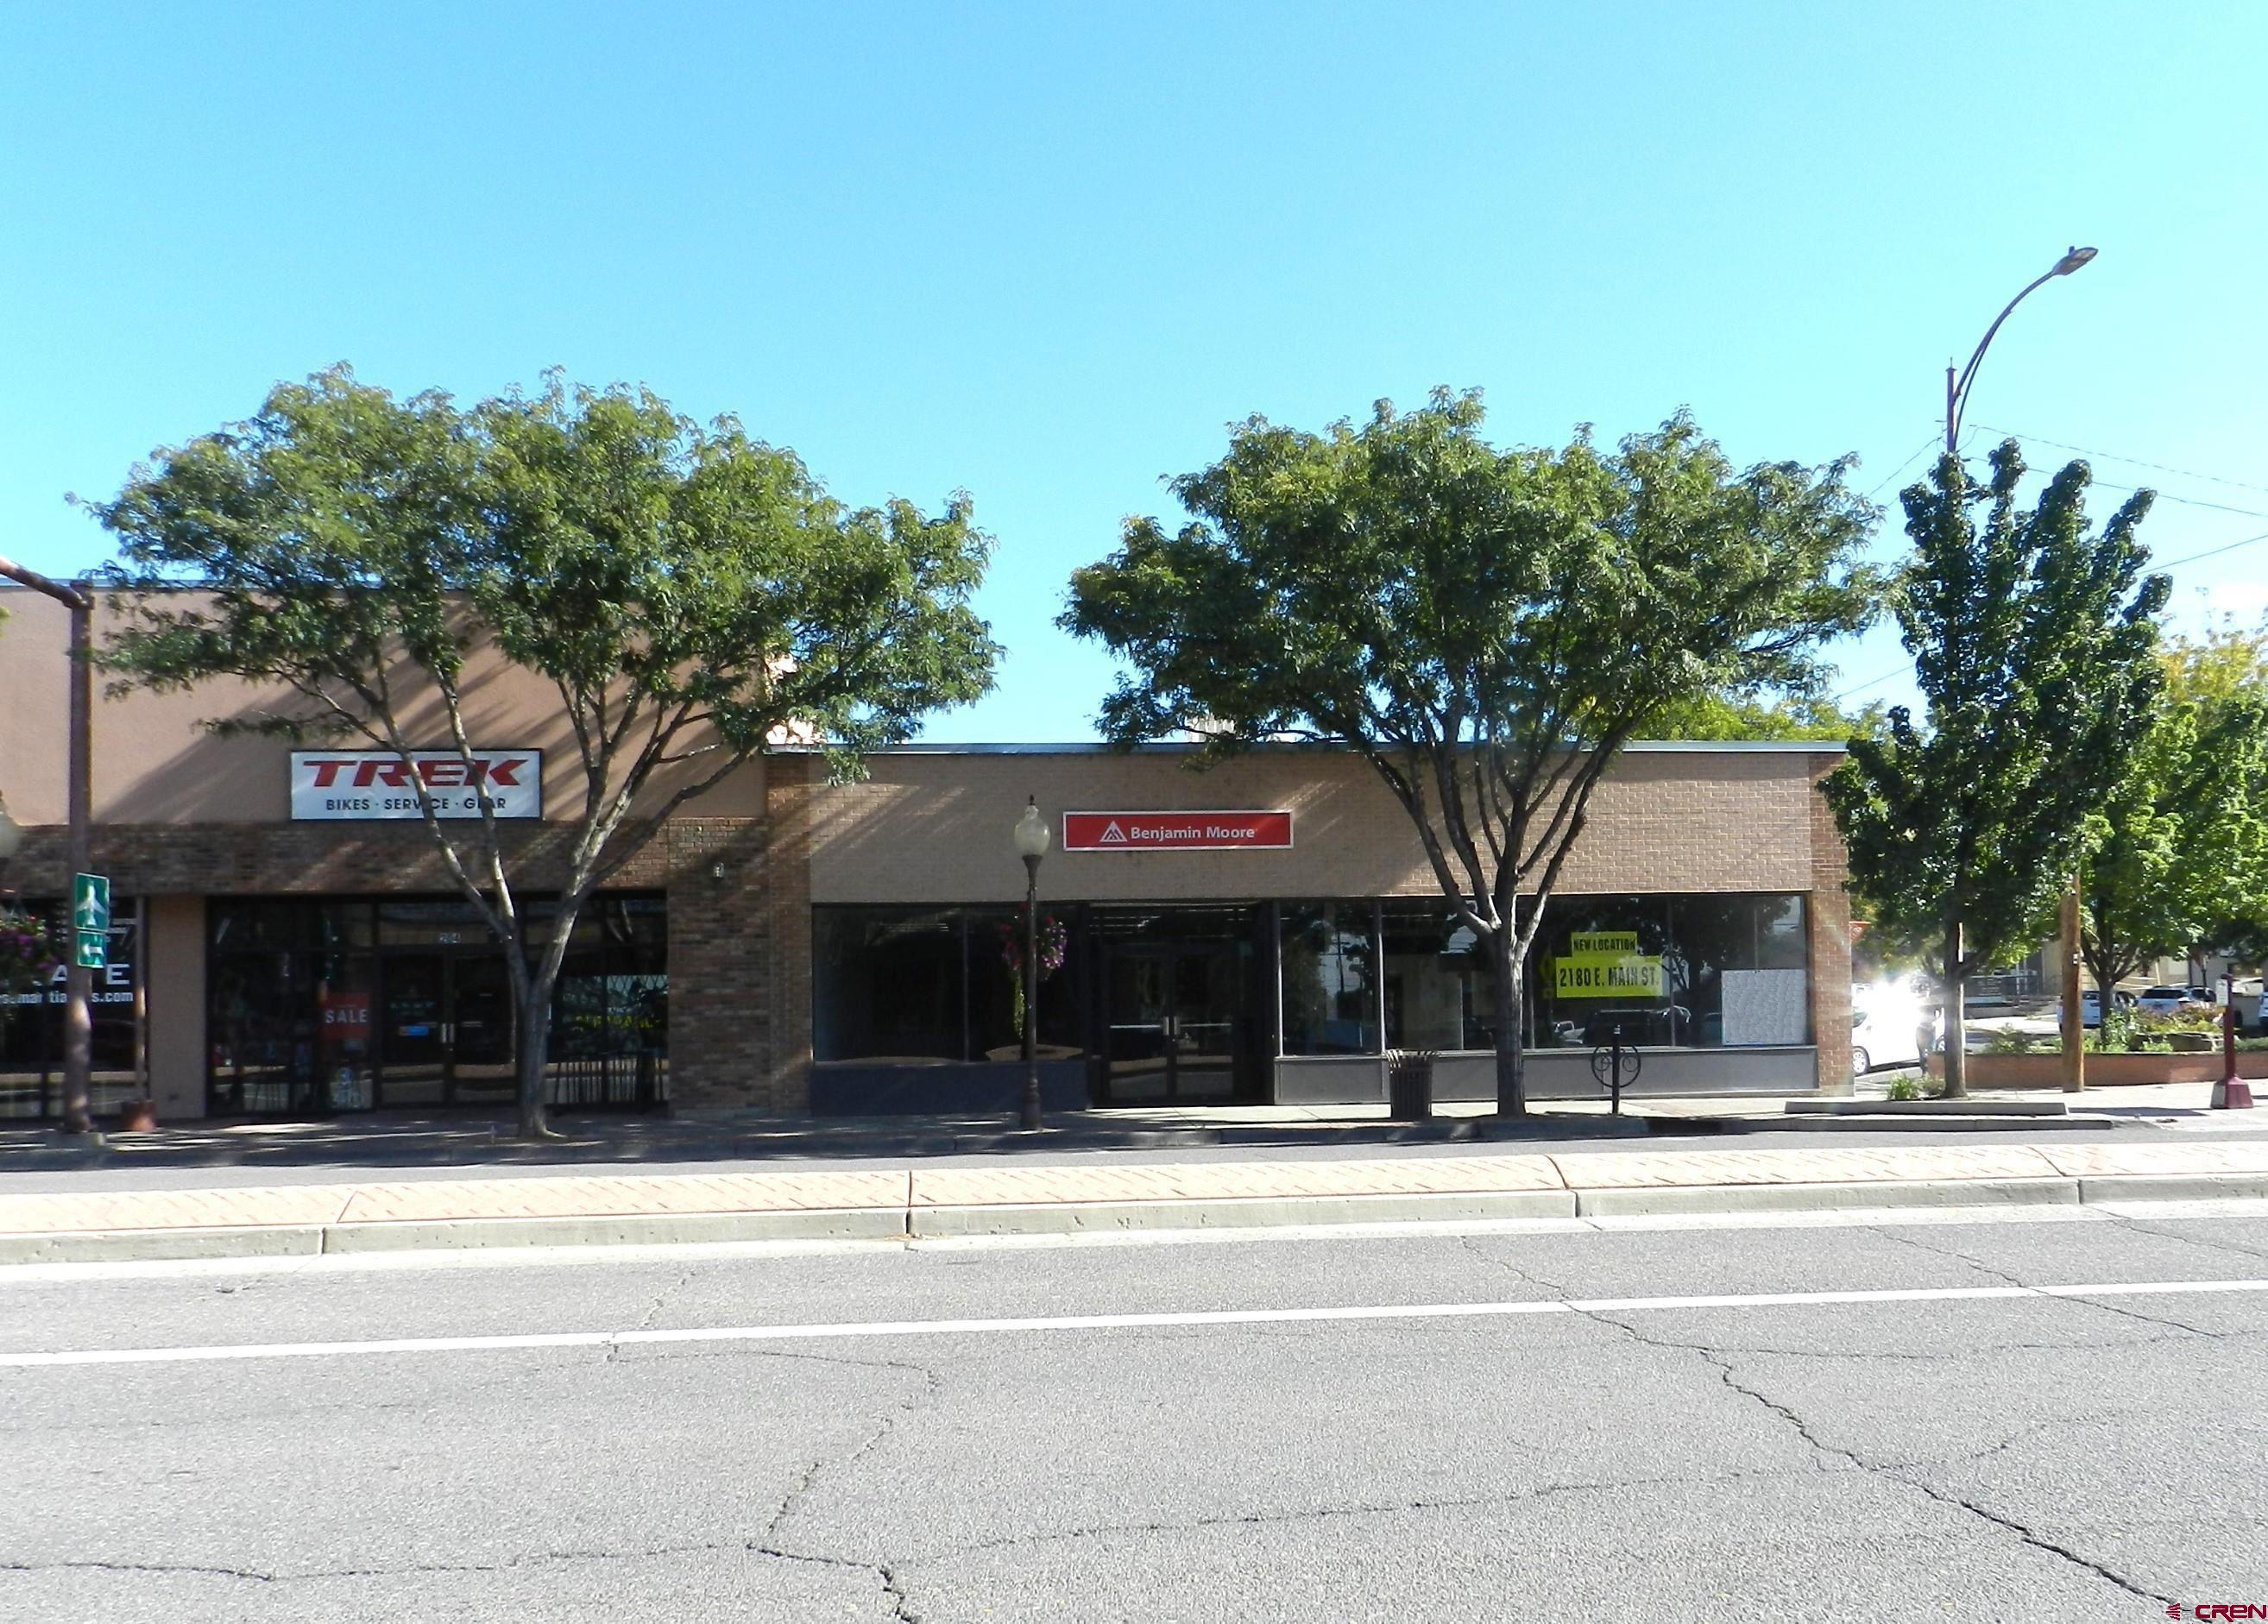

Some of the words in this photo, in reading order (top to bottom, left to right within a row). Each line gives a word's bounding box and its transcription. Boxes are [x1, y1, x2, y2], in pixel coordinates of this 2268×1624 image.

[303, 758, 529, 787] TREK
[326, 799, 370, 810] BIKES
[384, 798, 449, 809] SERVCE
[1131, 826, 1201, 842] Benjamin
[1206, 826, 1255, 839] Moore
[1573, 939, 1591, 951] NEW
[1593, 938, 1636, 950] LOCATION
[1559, 967, 1591, 987] 2180
[1594, 967, 1604, 986] E.
[1608, 966, 1638, 985] MAIN
[1641, 966, 1659, 985] ST.
[325, 1009, 368, 1023] SALE
